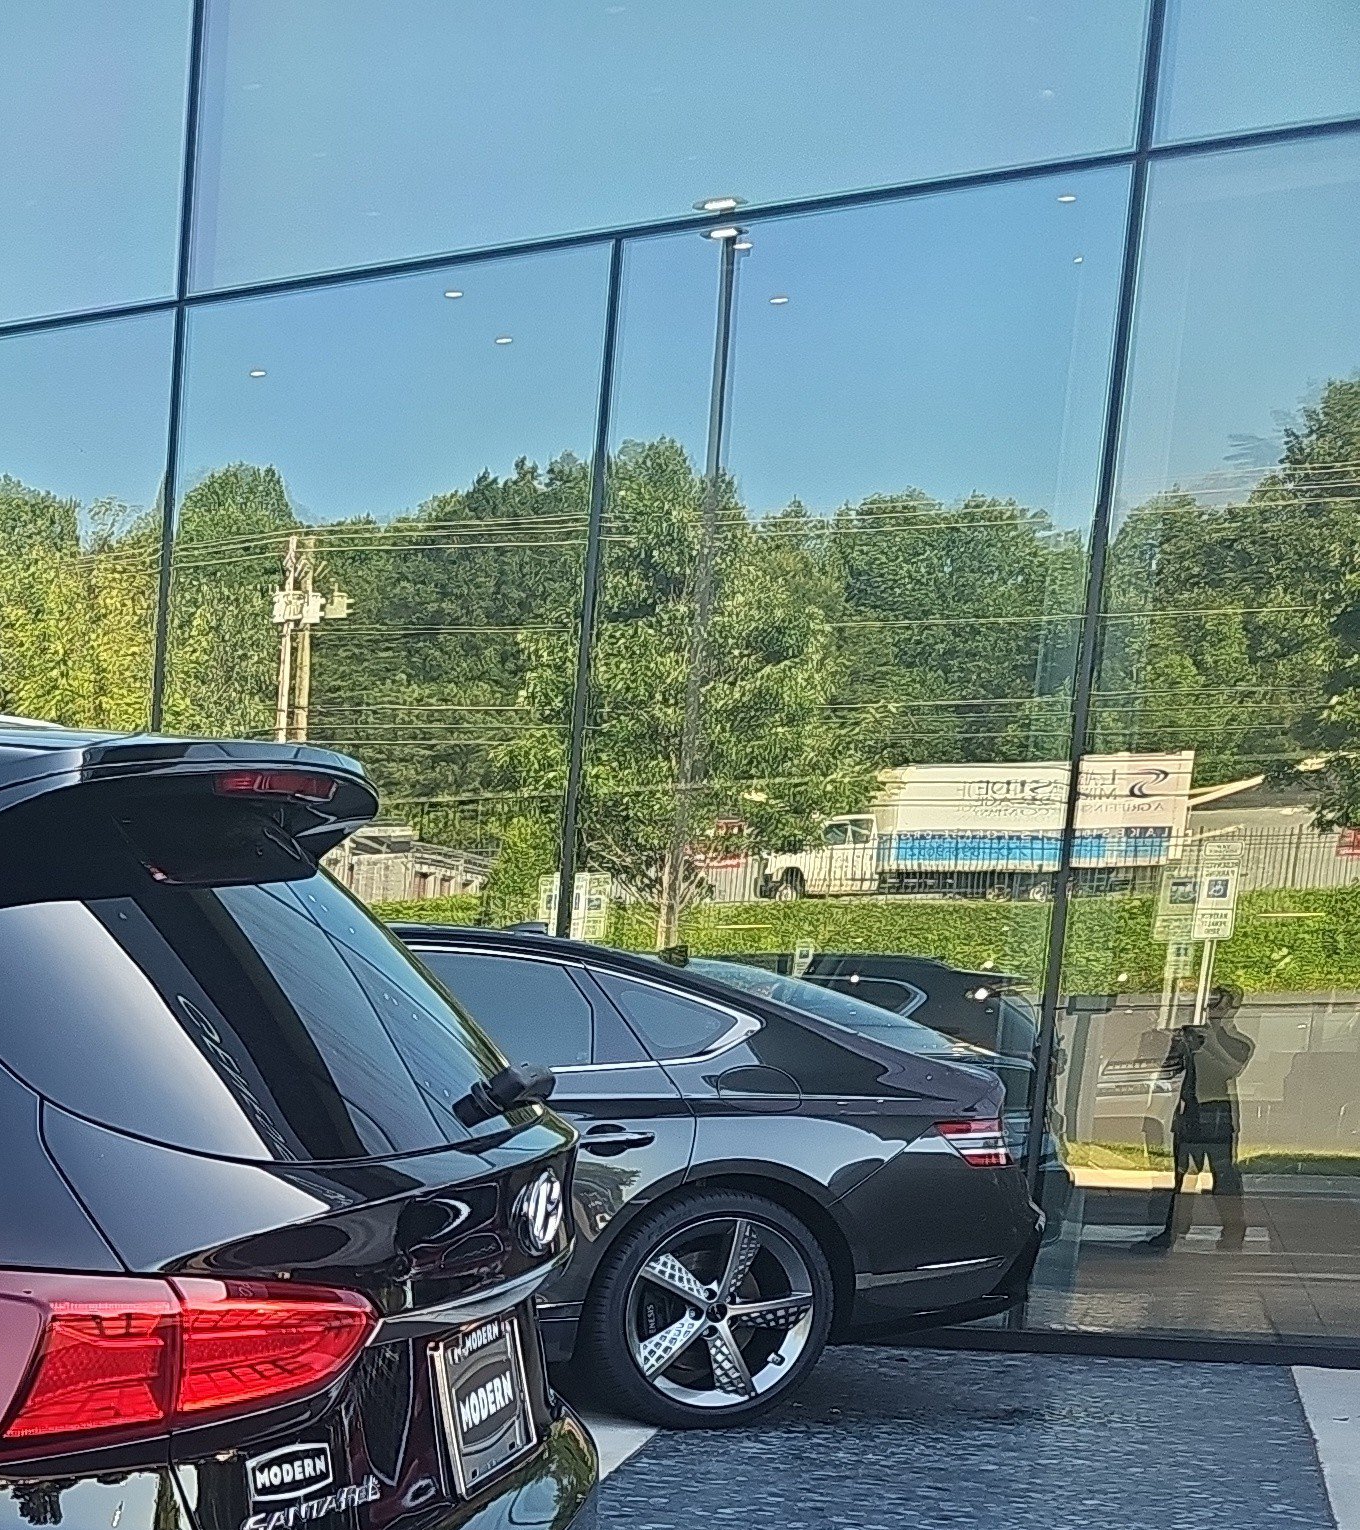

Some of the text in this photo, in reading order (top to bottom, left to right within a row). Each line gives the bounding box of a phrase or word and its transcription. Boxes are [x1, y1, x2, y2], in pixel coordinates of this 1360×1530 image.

[646, 1304, 657, 1334] ENESIS
[463, 1320, 500, 1354] MODERN
[459, 1370, 514, 1433] MODERN
[255, 1454, 327, 1490] MODERN
